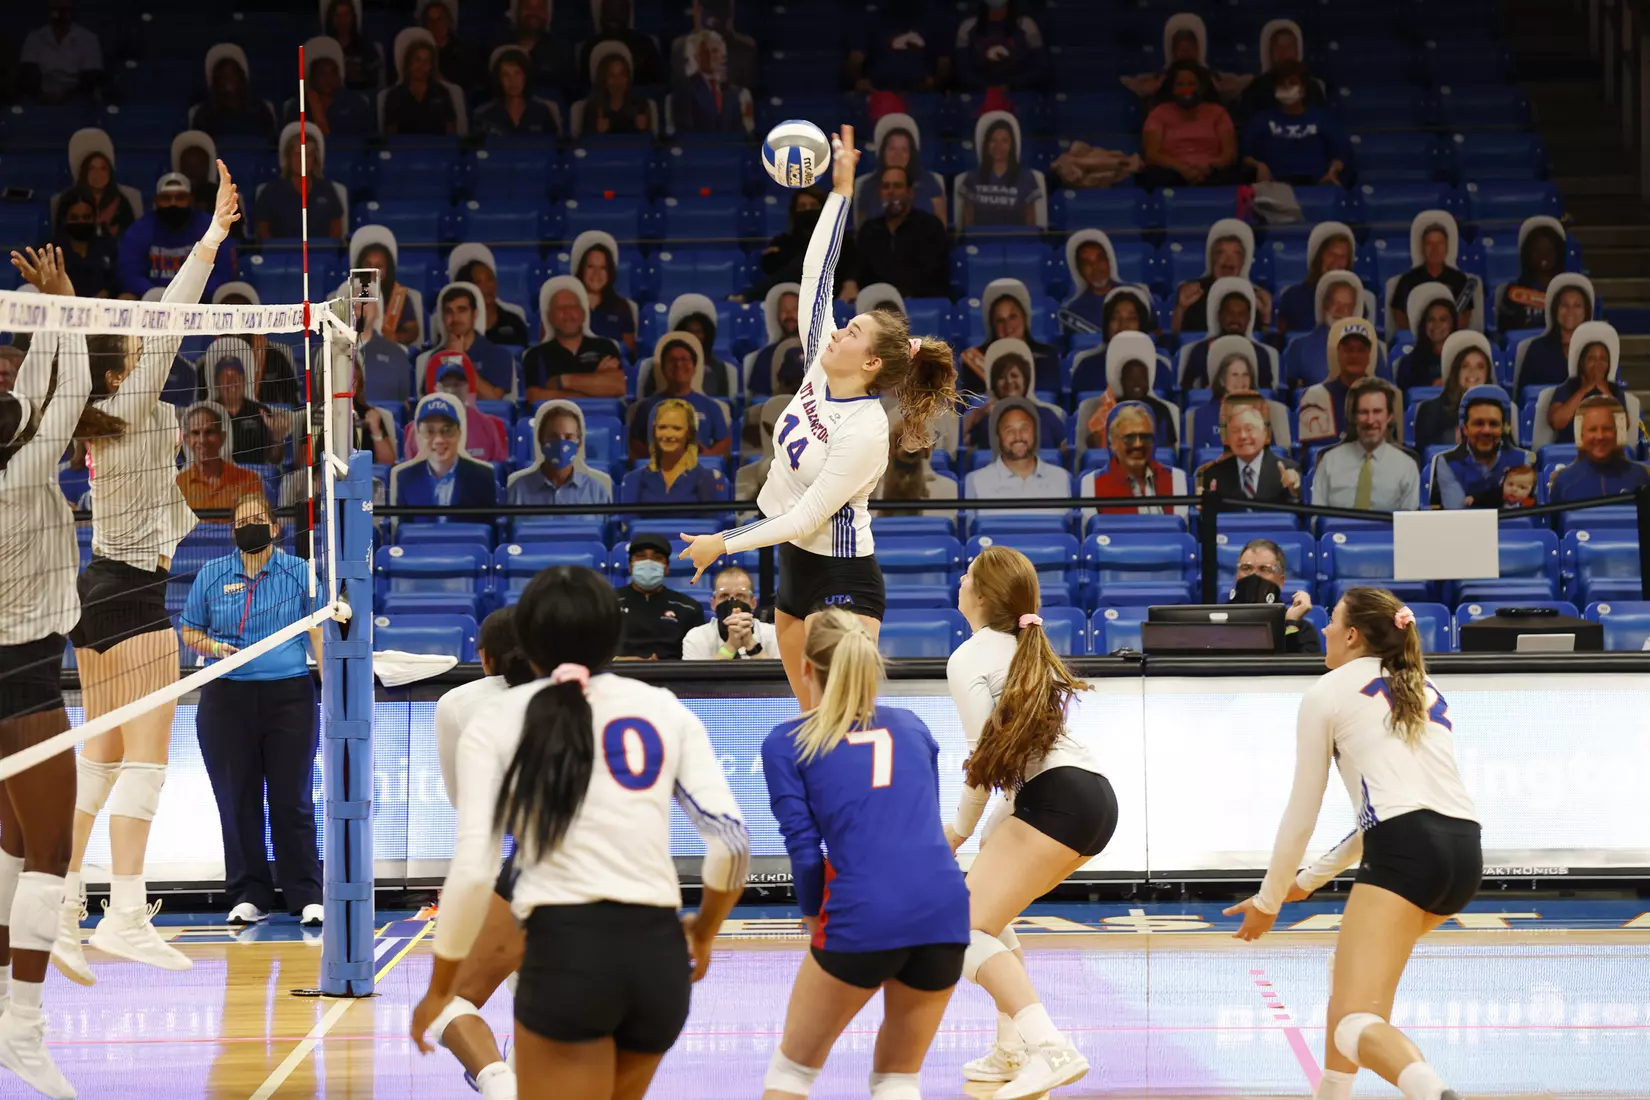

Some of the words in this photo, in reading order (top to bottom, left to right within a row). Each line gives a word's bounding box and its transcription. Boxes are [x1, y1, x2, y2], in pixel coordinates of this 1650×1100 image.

[975, 184, 1018, 196] TEXAS
[427, 401, 449, 412] UTA
[778, 413, 809, 472] 14
[824, 594, 855, 605] UTA
[602, 717, 664, 791] 0
[845, 727, 894, 789] 7
